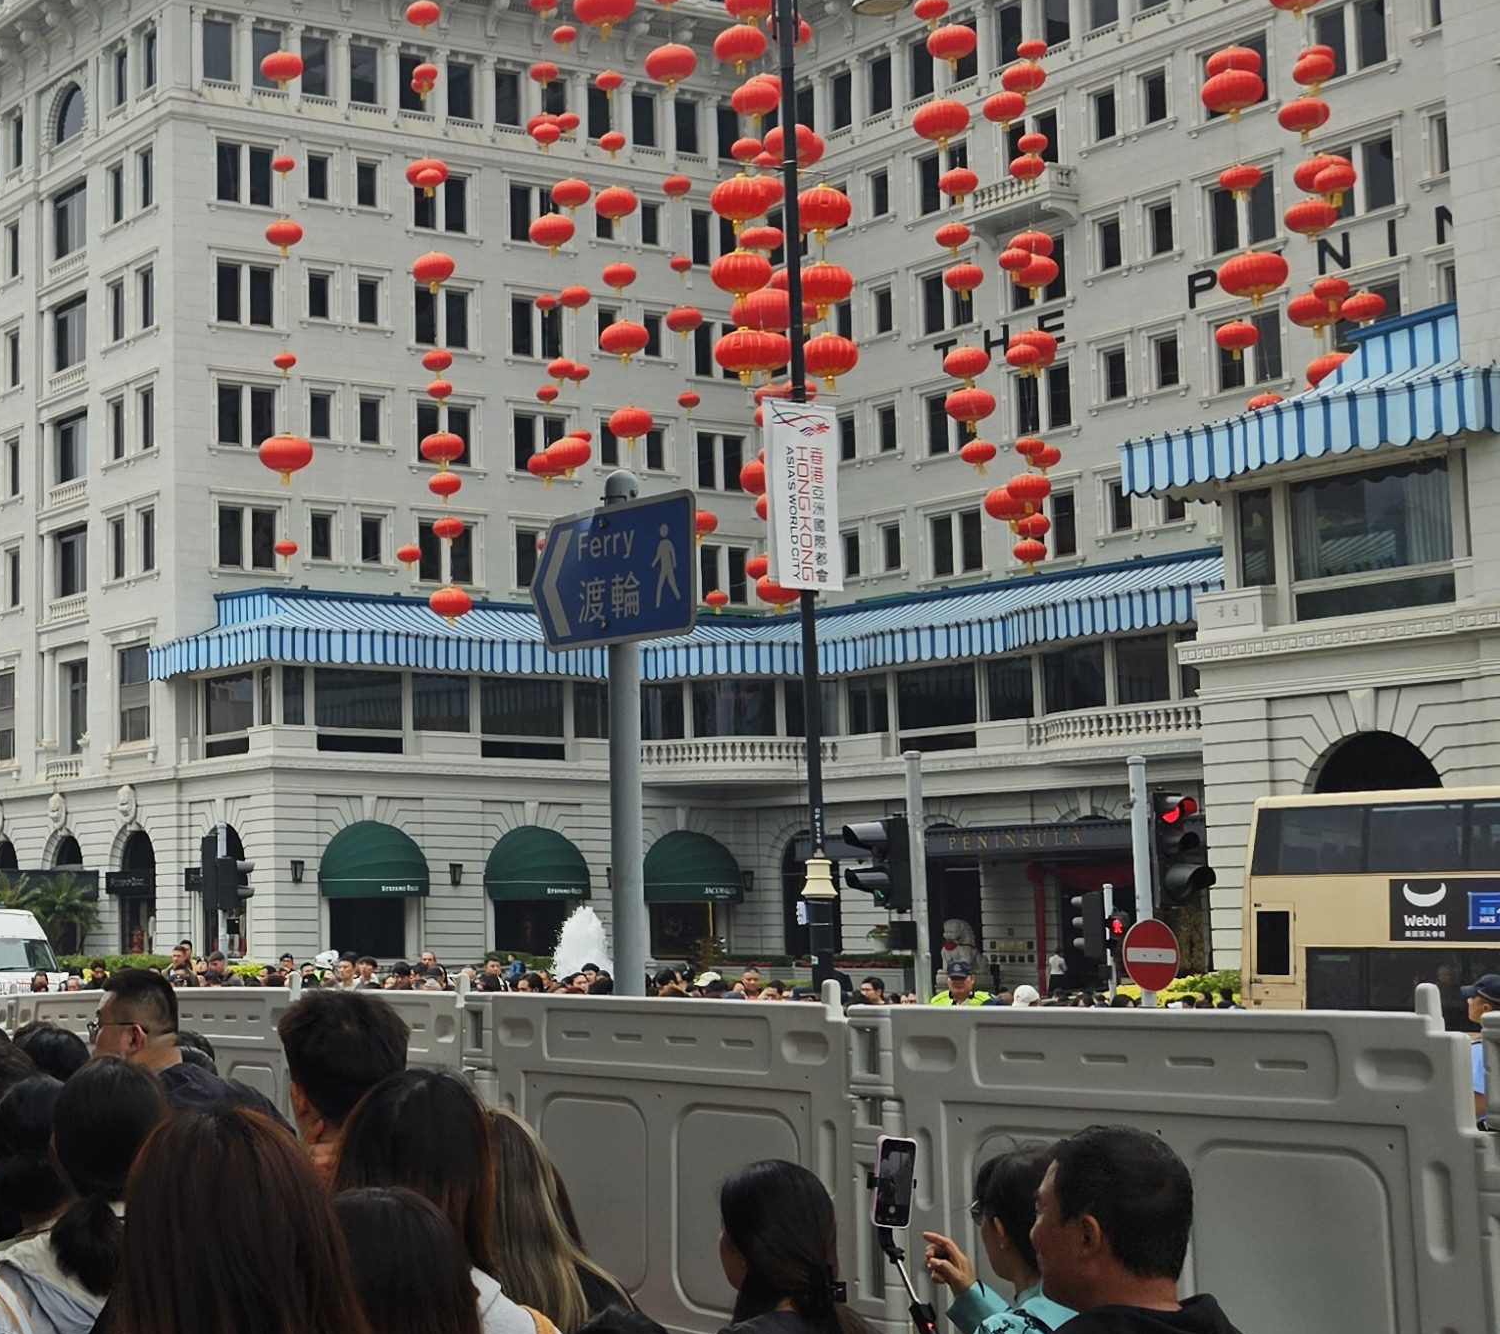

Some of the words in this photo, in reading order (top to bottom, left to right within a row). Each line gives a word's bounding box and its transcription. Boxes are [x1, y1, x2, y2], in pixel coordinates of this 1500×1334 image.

[786, 446, 796, 490] ASIA'S
[796, 446, 811, 511] HONG
[788, 494, 799, 545] WORLD
[578, 529, 635, 561] Ferry
[791, 546, 801, 581] CITY
[799, 516, 814, 582] KONG
[578, 570, 640, 624] 渡輪
[949, 832, 1082, 850] PENINSULA
[1404, 914, 1446, 927] Webull
